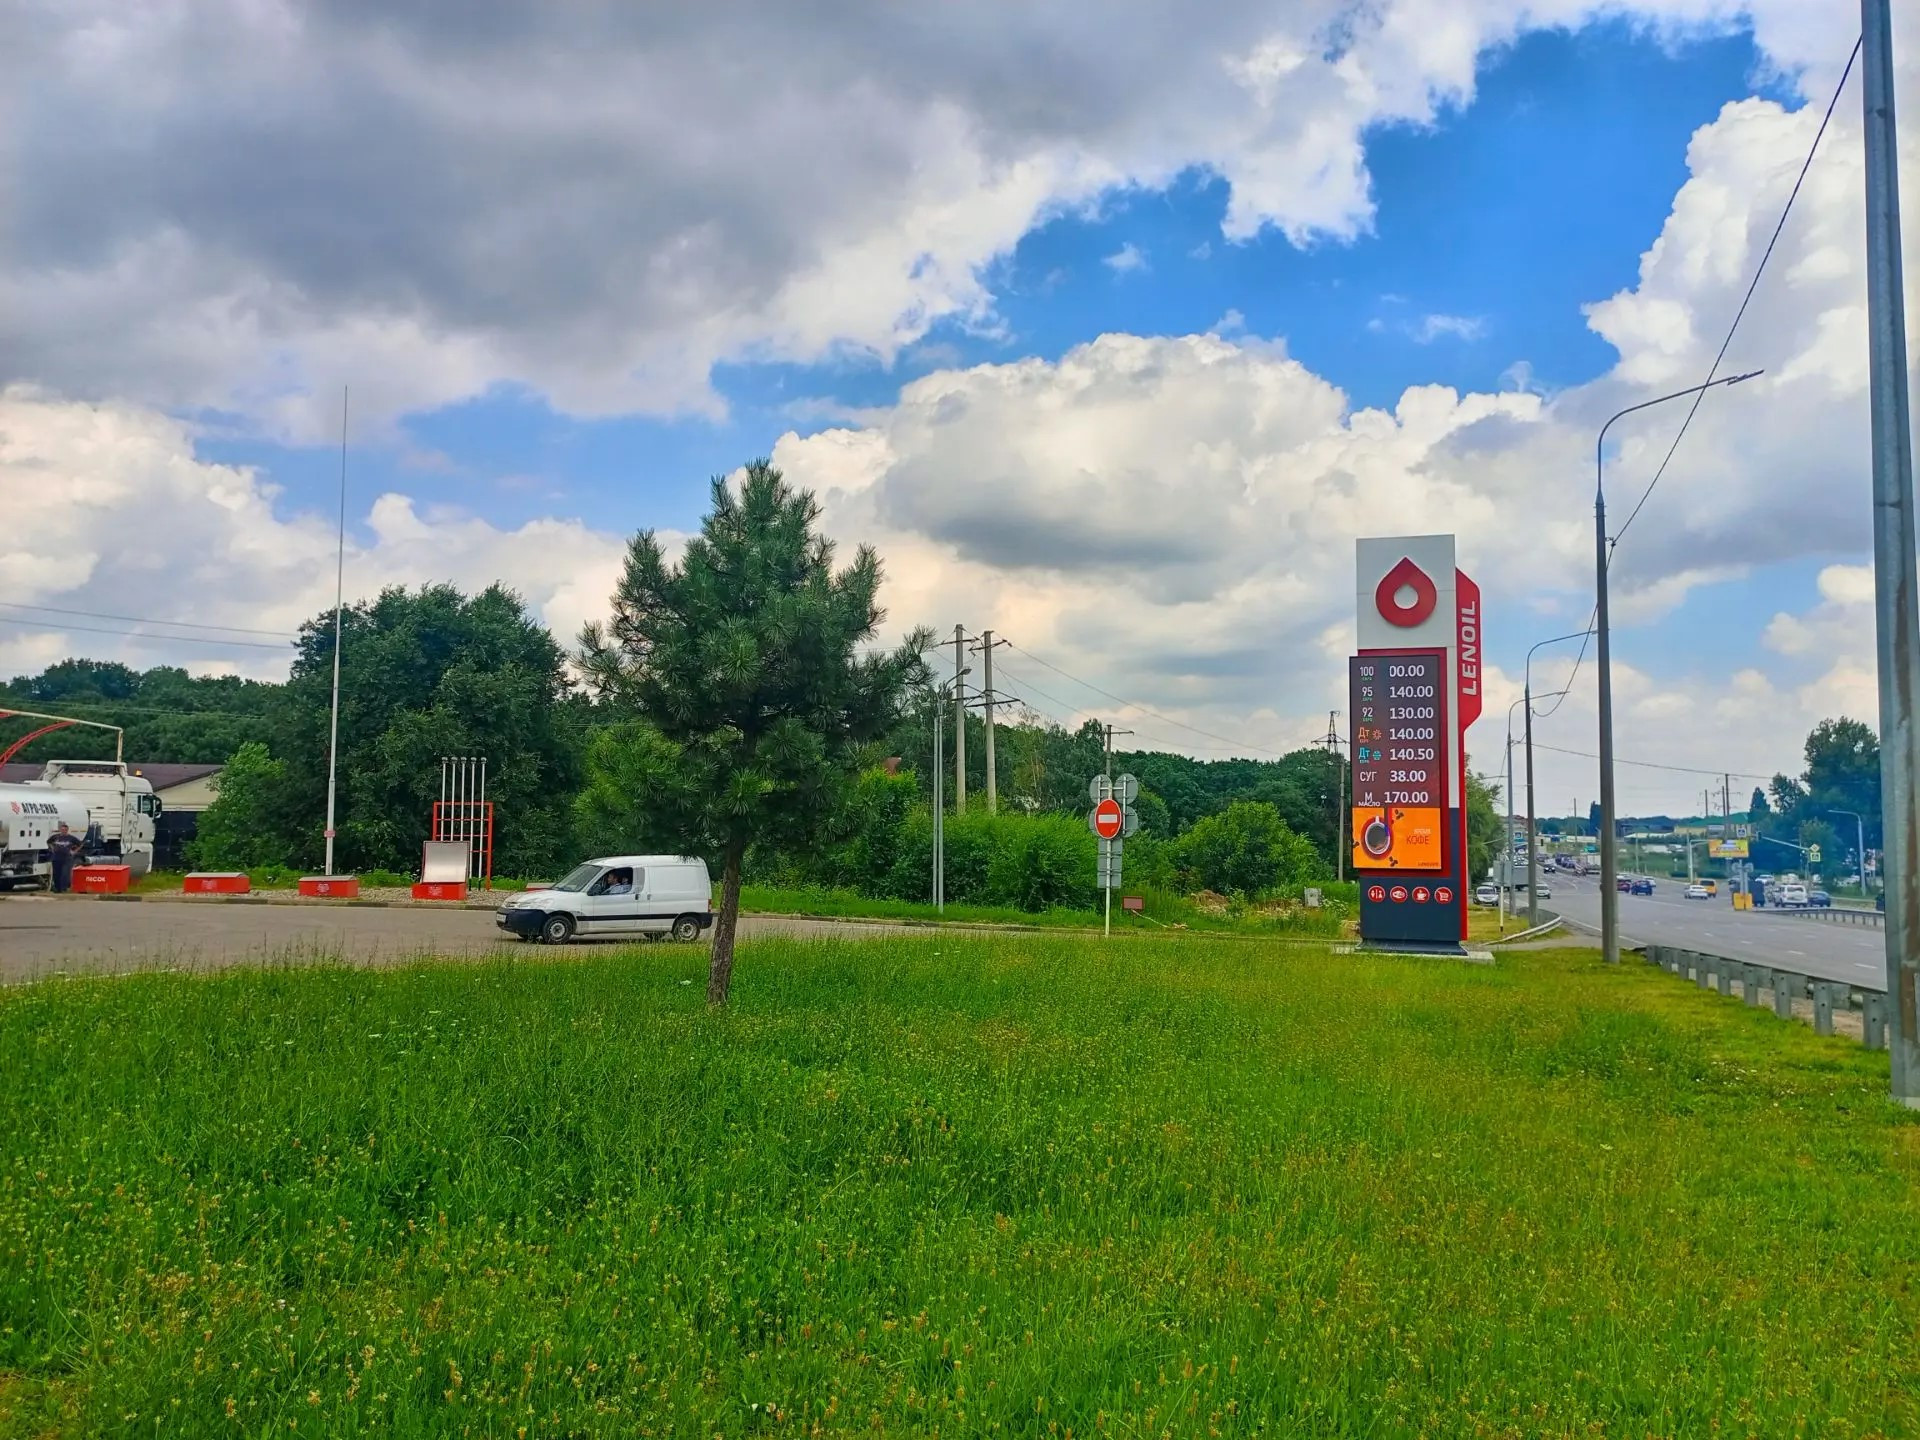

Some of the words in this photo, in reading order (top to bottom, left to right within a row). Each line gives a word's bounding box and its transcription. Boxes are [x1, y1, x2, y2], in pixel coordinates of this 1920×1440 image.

[1461, 600, 1477, 696] LENOIL
[1359, 666, 1374, 677] 100
[1389, 665, 1425, 677] 00.00
[1362, 686, 1373, 696] 95
[1389, 685, 1434, 698] 140.00
[1362, 707, 1373, 717] 92
[1389, 707, 1434, 720] 130.00
[1389, 727, 1434, 740] 140.00
[1389, 748, 1434, 761] 140.50
[1359, 771, 1377, 782] СУГ
[1389, 770, 1427, 782] 38.00
[1383, 791, 1429, 804] 170.00
[1406, 835, 1430, 845] КОФЕ
